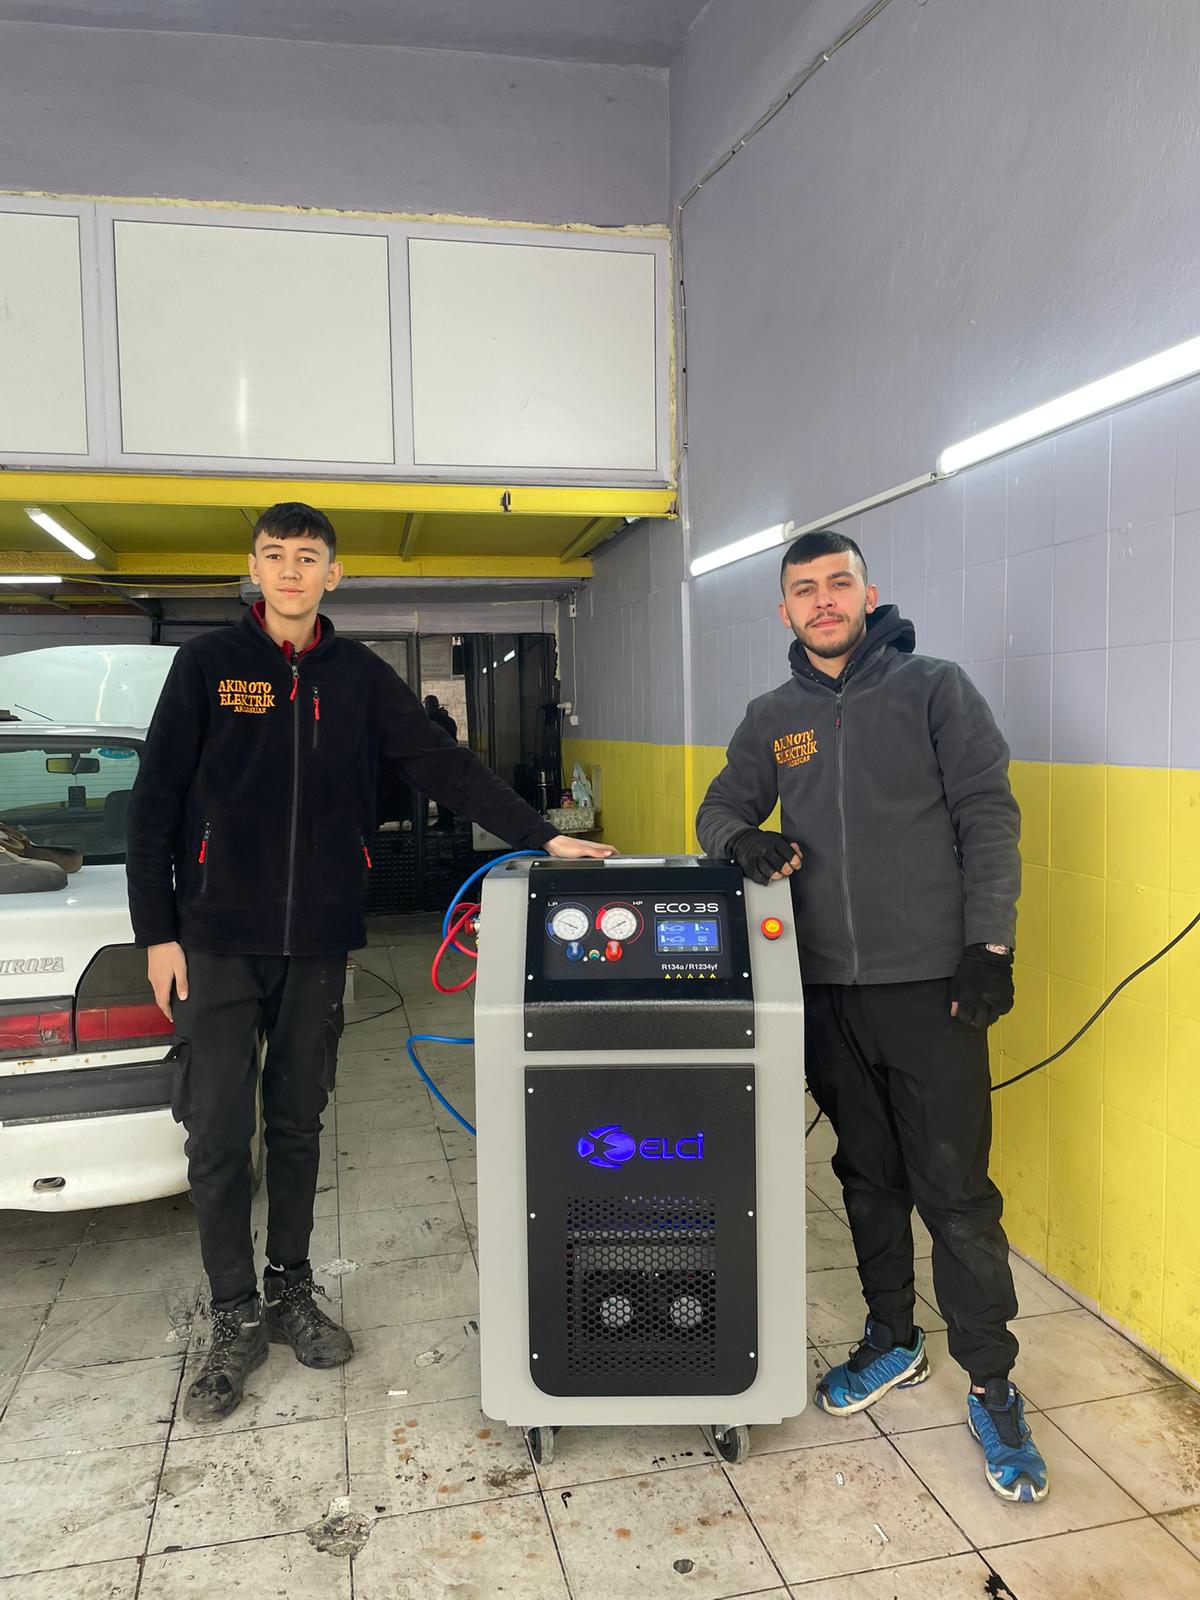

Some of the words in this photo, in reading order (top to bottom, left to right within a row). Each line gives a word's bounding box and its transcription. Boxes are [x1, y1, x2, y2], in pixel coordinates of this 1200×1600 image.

[217, 679, 247, 693] AKIN
[248, 681, 272, 694] OTO
[219, 692, 276, 707] ELEKTRİK
[773, 733, 793, 752] AKN
[793, 729, 814, 745] OTO
[654, 902, 691, 913] ECO
[693, 902, 719, 913] 3S
[661, 963, 684, 971] R134a
[688, 963, 718, 972] R1234yf
